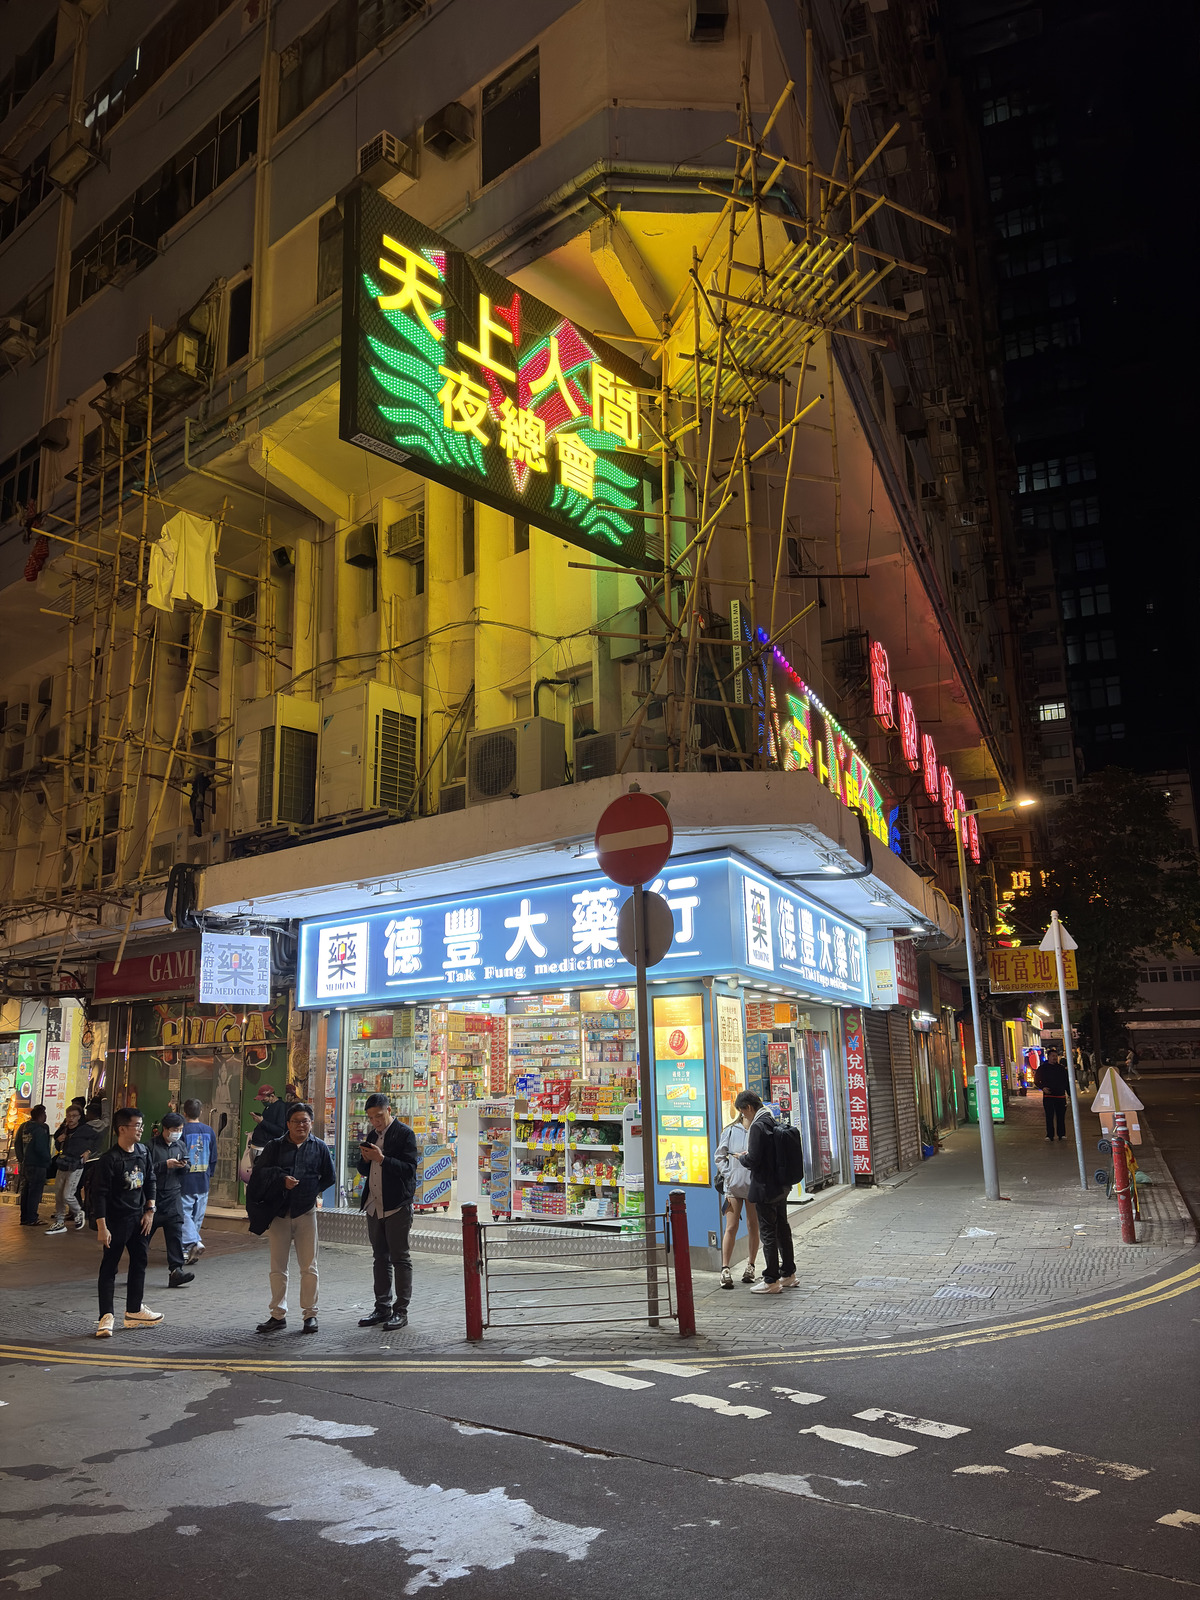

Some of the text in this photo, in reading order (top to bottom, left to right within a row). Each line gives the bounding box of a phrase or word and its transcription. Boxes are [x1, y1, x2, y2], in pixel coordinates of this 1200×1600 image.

[377, 234, 640, 449] 天上人間
[437, 365, 598, 500] 夜總會
[750, 888, 768, 948] 藥
[777, 897, 860, 982] 德豐大藥行
[217, 943, 254, 987] 藥
[257, 945, 269, 996] 優質正貨
[327, 931, 357, 980] 藥
[445, 956, 615, 983] Tak Fung medicine
[214, 987, 256, 996] MEDICINE
[993, 982, 1010, 991] HANG
[45, 1047, 61, 1098] 麻辣王
